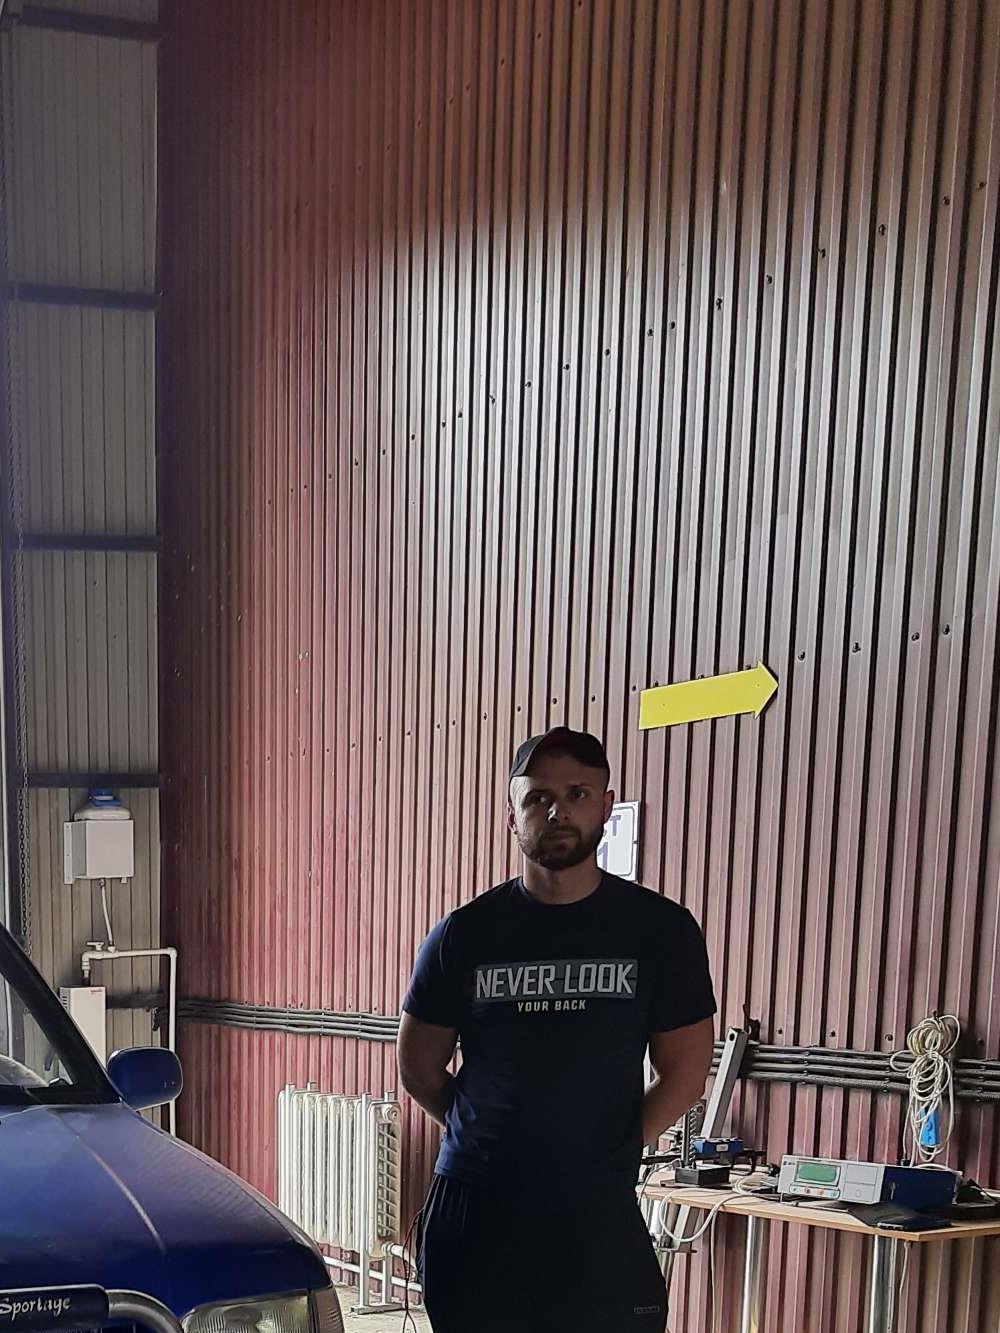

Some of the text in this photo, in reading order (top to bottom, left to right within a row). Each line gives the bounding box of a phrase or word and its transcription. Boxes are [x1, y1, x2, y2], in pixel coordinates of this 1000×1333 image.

[476, 963, 633, 998] NEVER LOOK
[517, 1000, 586, 1012] YOUR BACK
